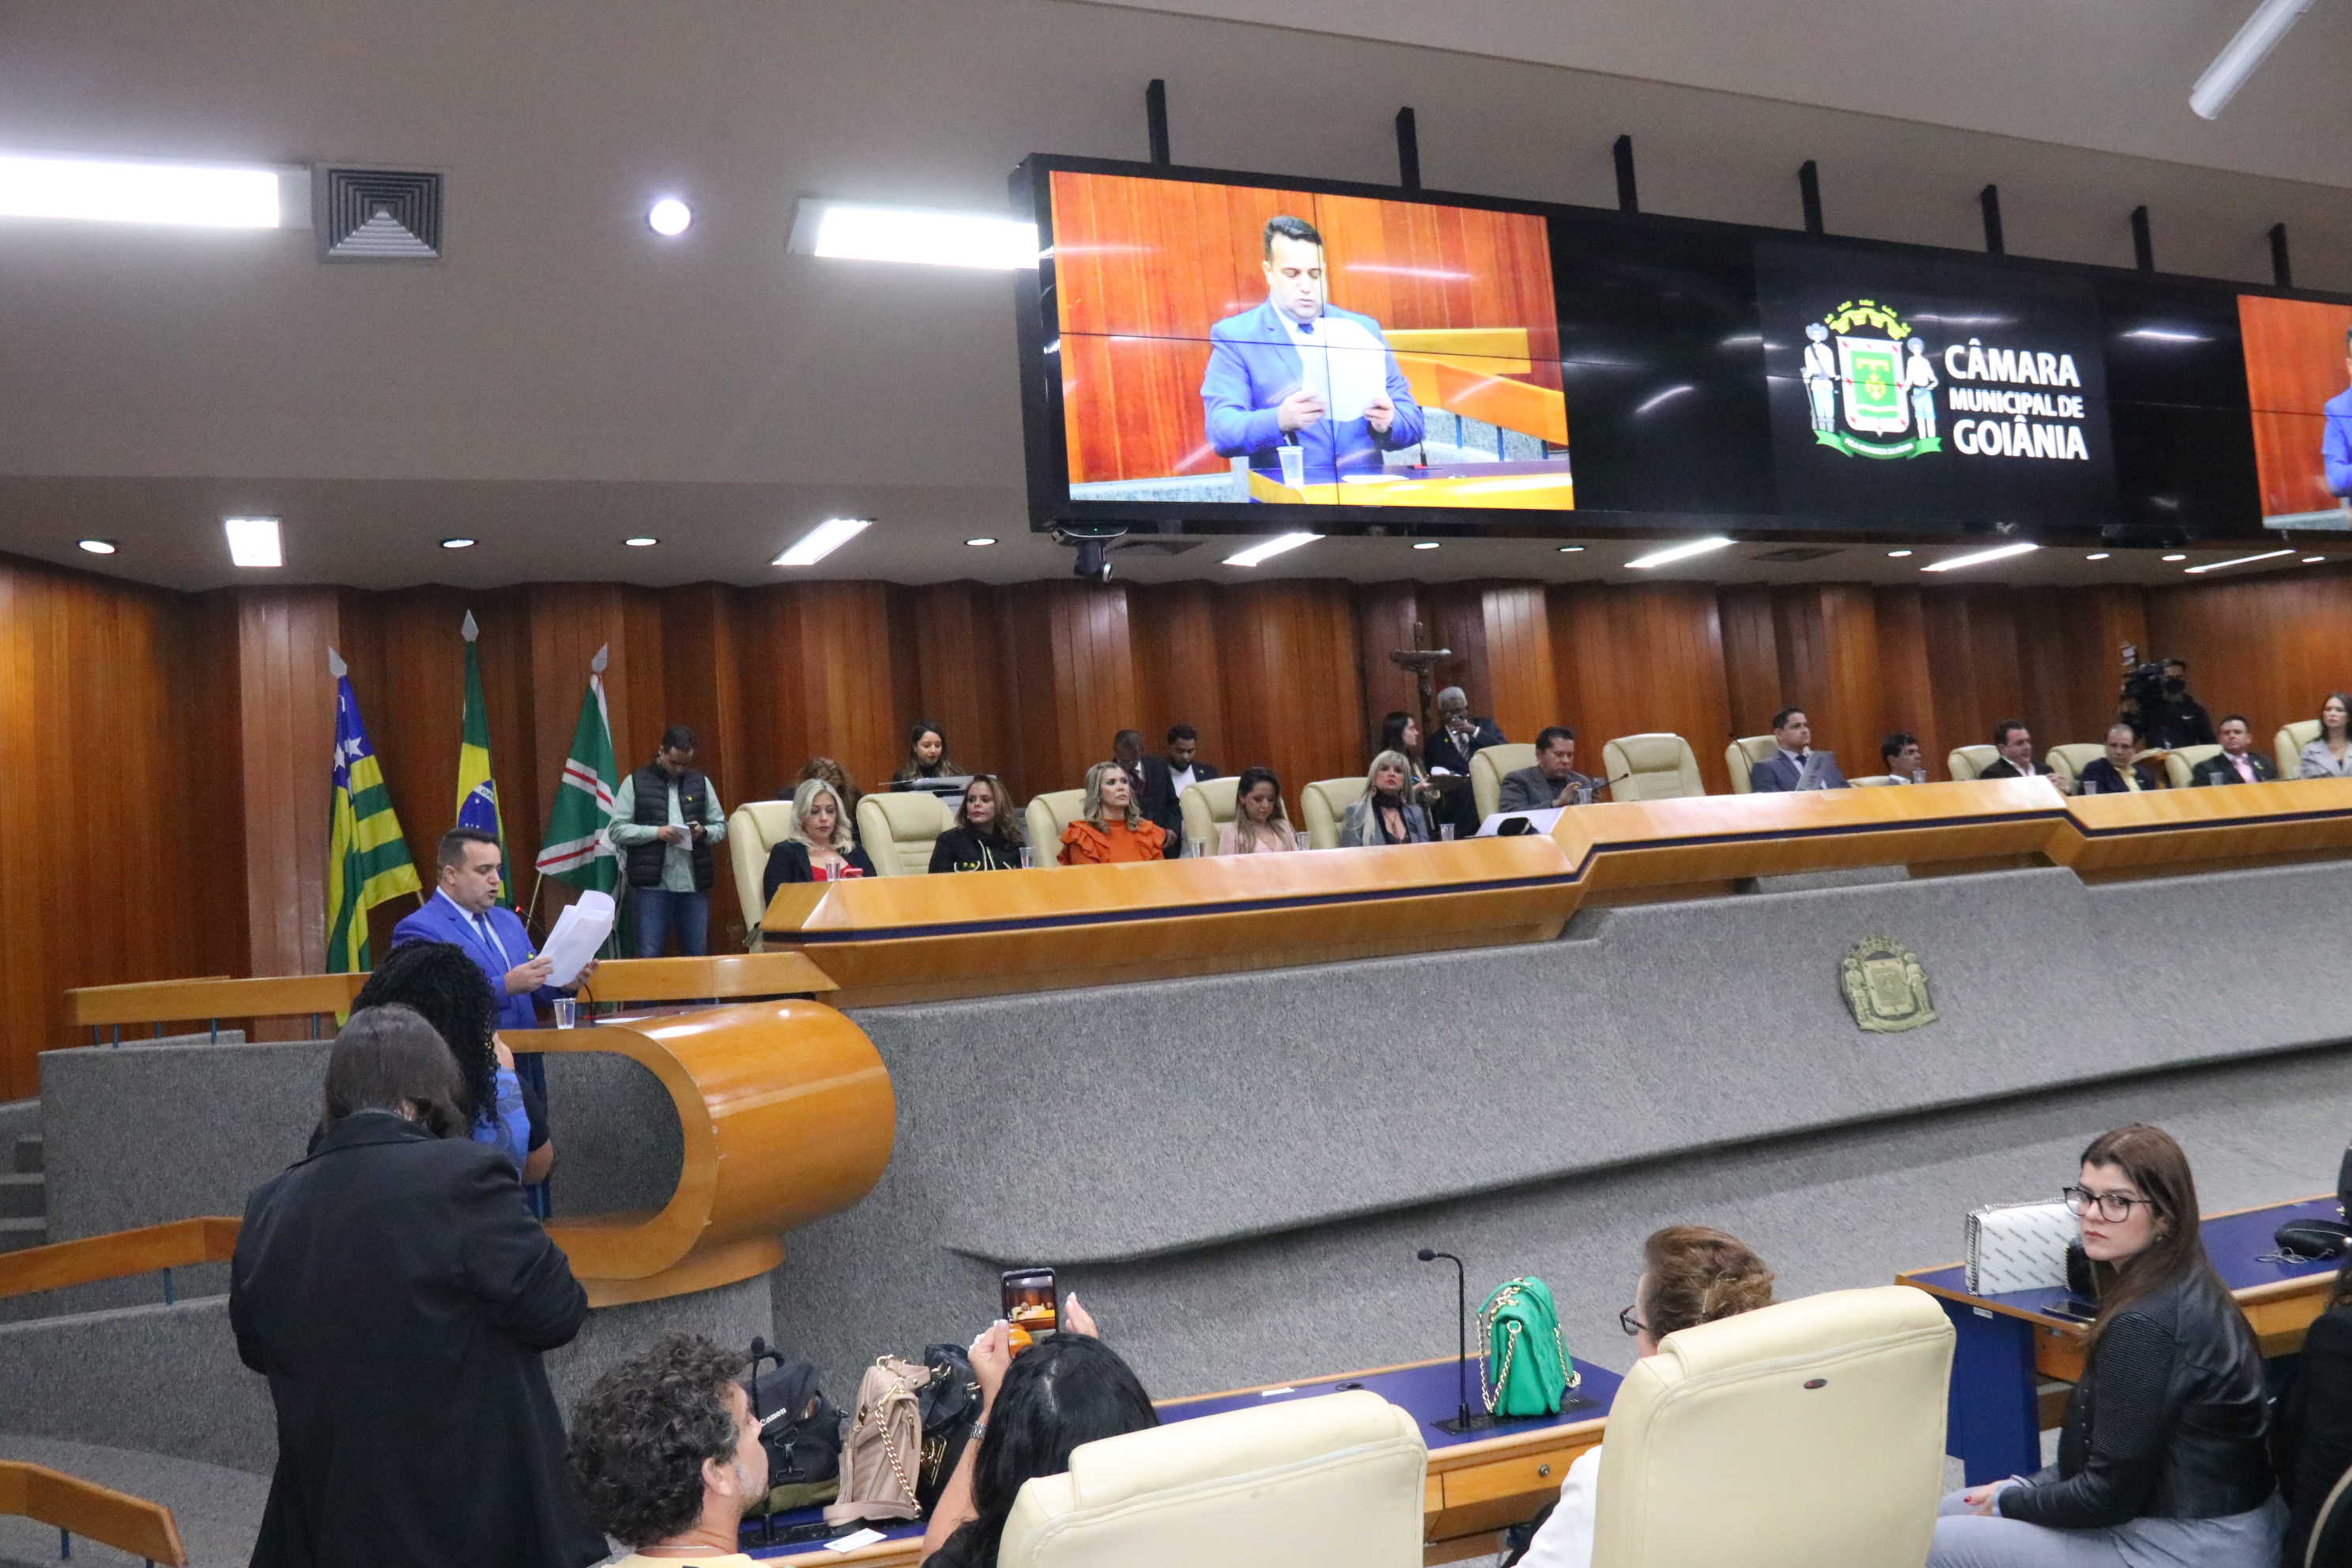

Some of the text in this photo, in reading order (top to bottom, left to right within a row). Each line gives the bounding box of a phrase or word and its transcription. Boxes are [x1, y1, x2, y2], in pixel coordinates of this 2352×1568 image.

[1944, 337, 2081, 388] CÂMARA
[1949, 386, 2085, 419] MUNICIPAL DE
[1953, 414, 2090, 461] GOIÂNIA
[760, 1408, 787, 1427] Canon
